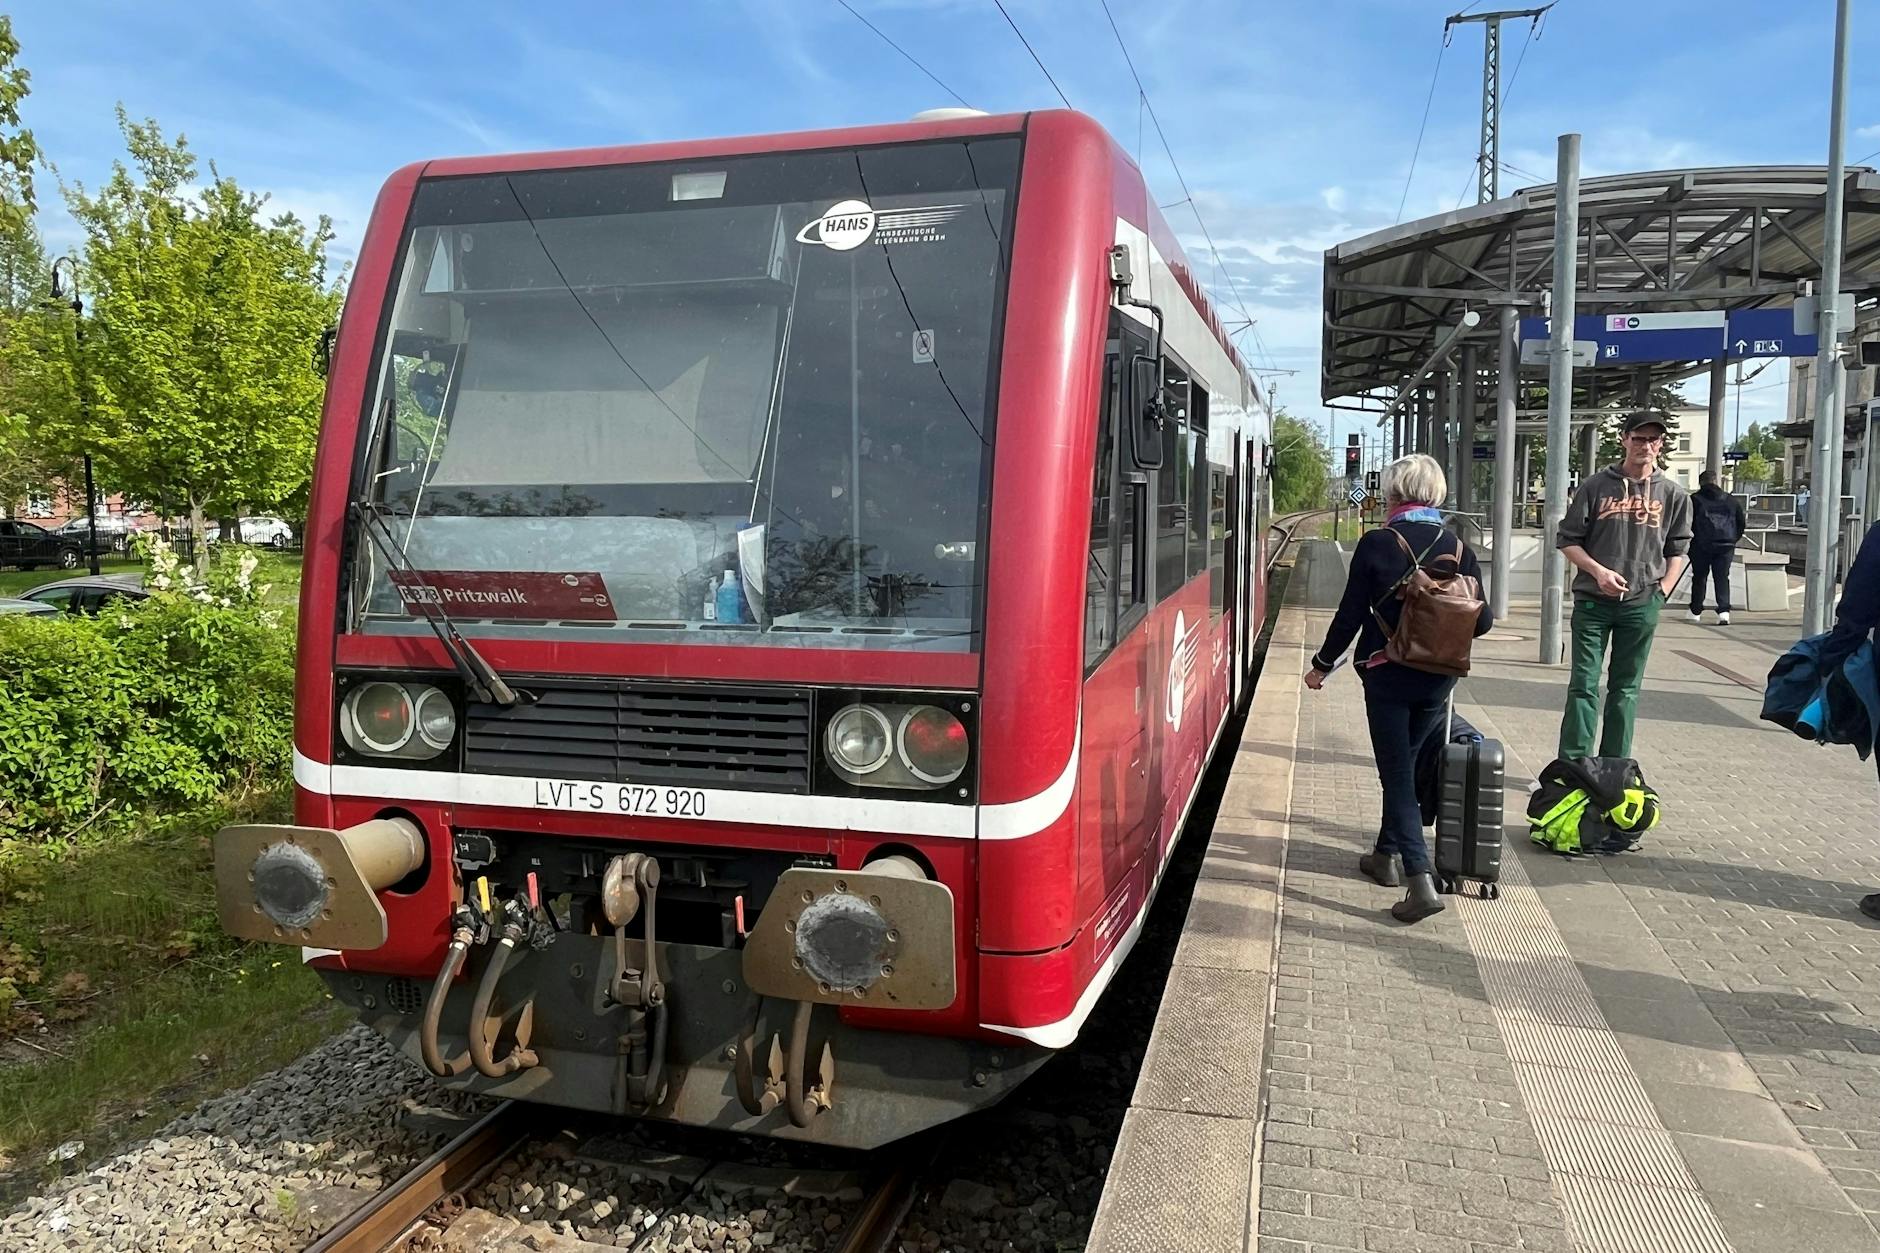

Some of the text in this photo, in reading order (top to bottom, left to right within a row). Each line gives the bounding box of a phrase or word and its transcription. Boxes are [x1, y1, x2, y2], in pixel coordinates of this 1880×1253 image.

[825, 217, 869, 232] HANS
[1368, 472, 1379, 489] H
[442, 588, 528, 604] Pritzwalk
[535, 781, 705, 816] LVT-S 672 920
